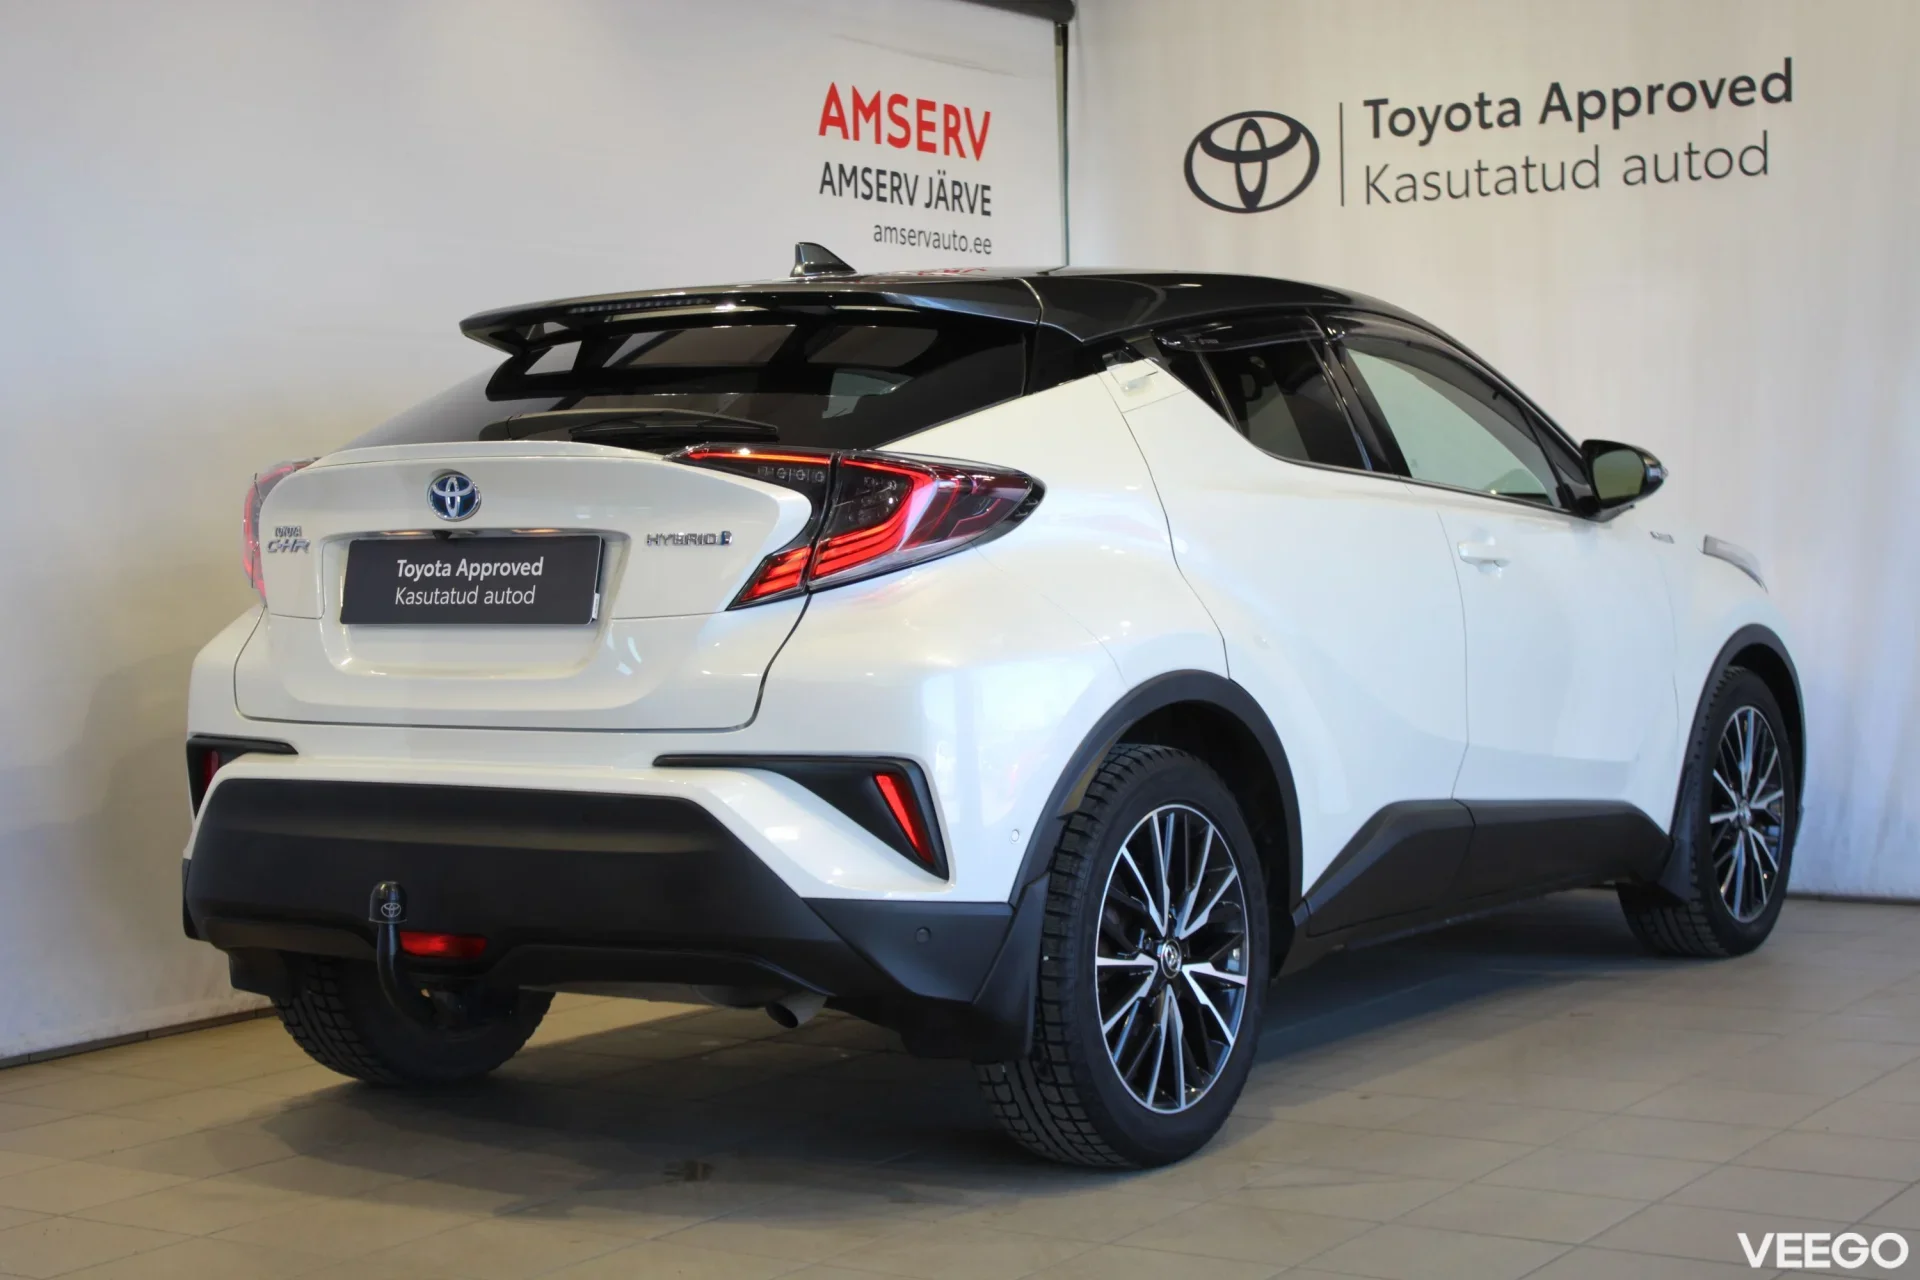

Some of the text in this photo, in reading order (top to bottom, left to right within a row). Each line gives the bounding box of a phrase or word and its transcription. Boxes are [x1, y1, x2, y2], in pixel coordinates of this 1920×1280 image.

[818, 81, 992, 162] AMSERV
[1363, 56, 1792, 147] Toyota Approved
[819, 161, 992, 217] AMSERV JÄRVE
[1365, 129, 1768, 205] Kasutatud autod
[873, 223, 992, 255] amservauto.ee
[646, 532, 718, 546] HYBRID
[396, 556, 544, 582] Toyota Approved
[395, 585, 536, 605] Kasutatud autod
